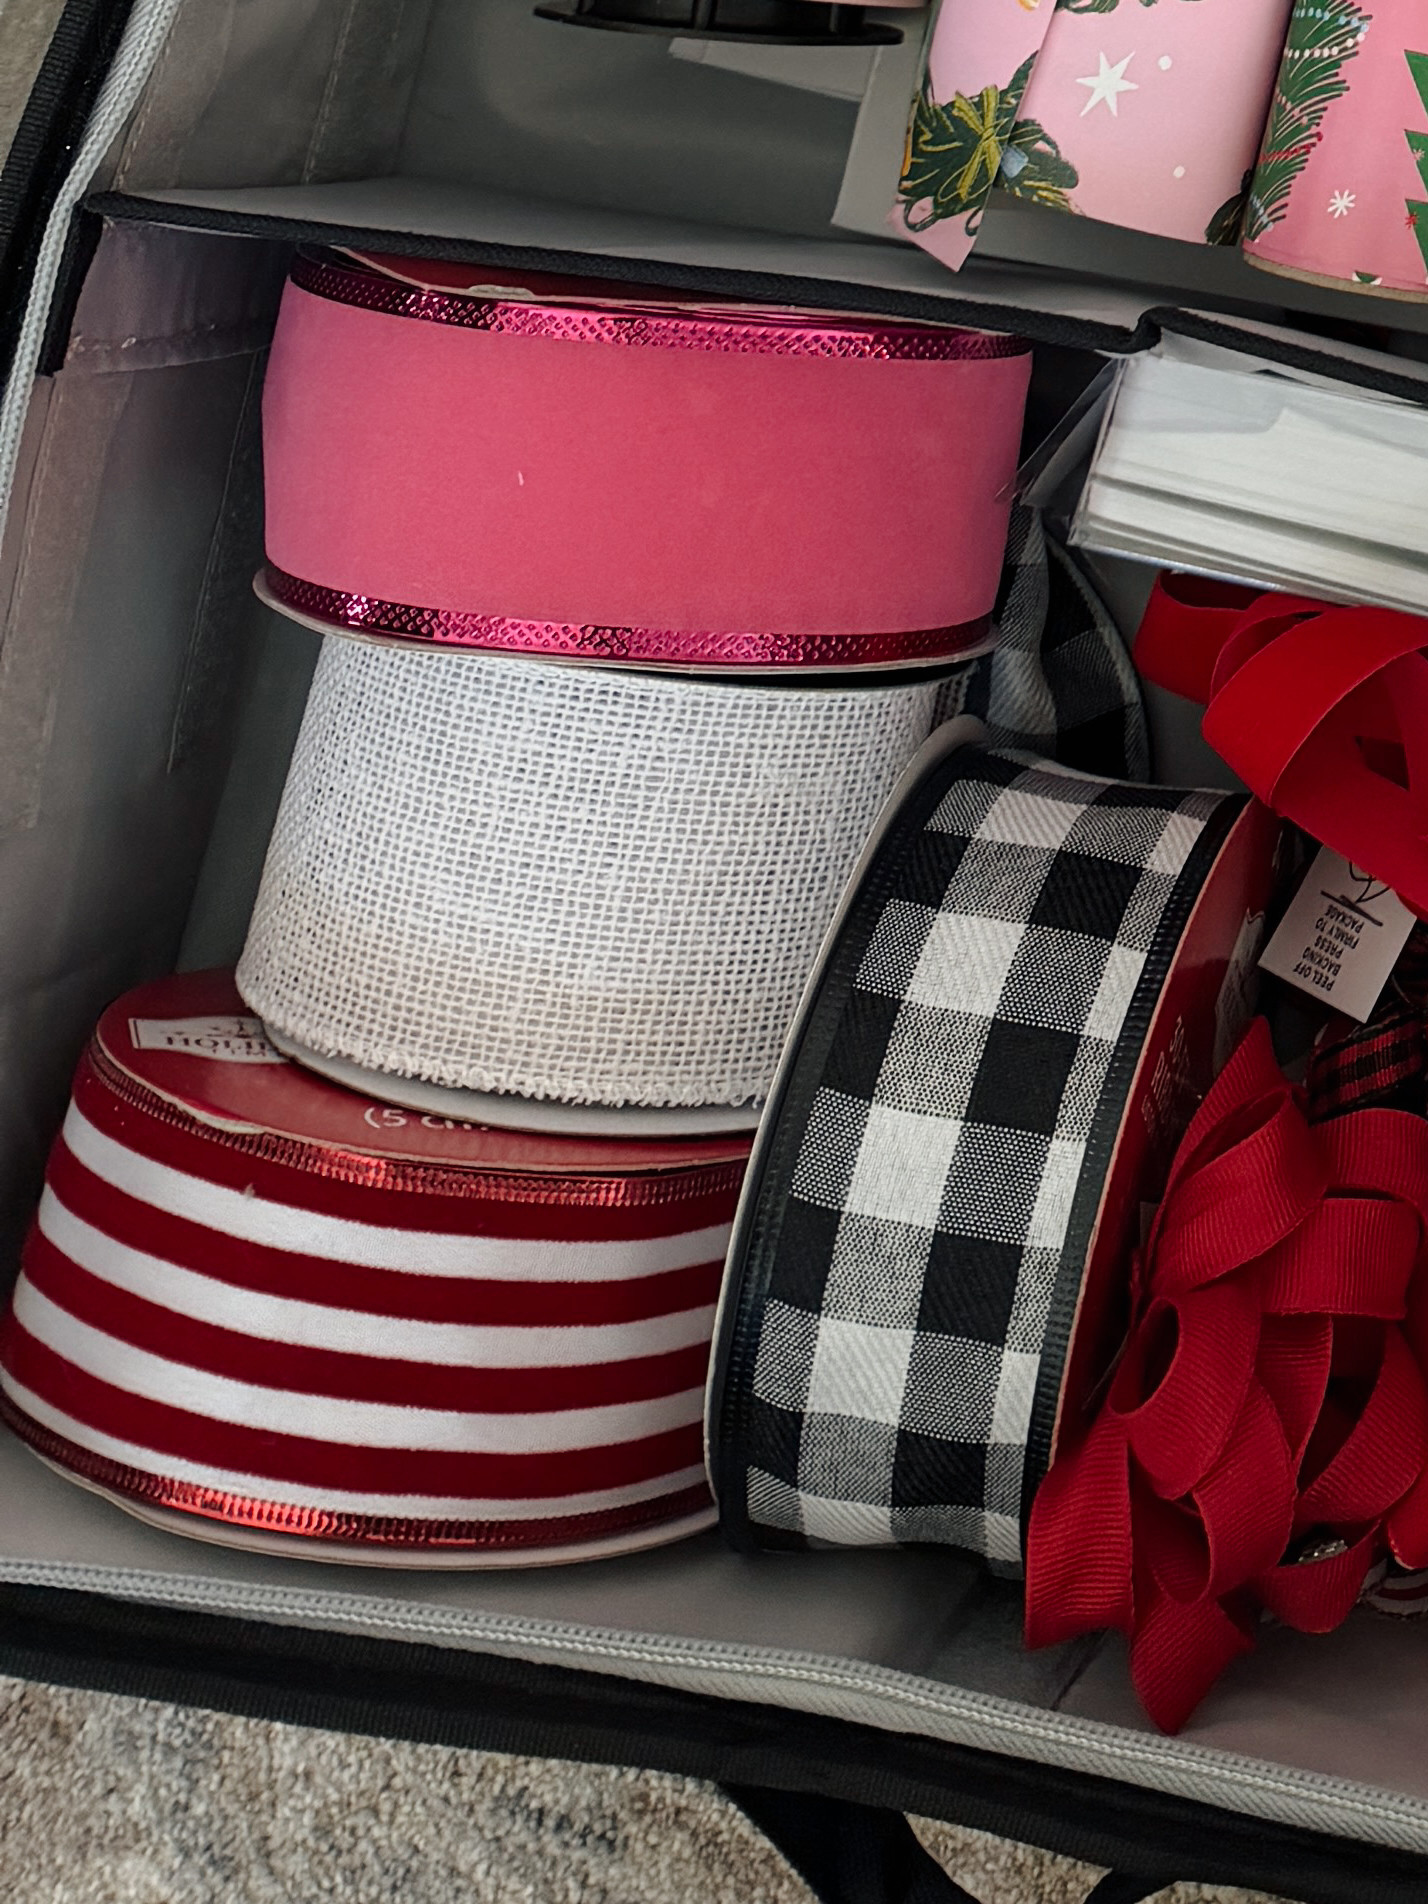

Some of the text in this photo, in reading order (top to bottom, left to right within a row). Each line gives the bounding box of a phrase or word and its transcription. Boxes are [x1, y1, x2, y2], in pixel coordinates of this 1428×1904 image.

[1315, 917, 1360, 949] FIRMLY TO
[1326, 904, 1365, 933] PACKAGE
[1302, 946, 1342, 977] BACKING
[1314, 935, 1345, 959] PRESS
[1292, 961, 1335, 991] PEEL OFF
